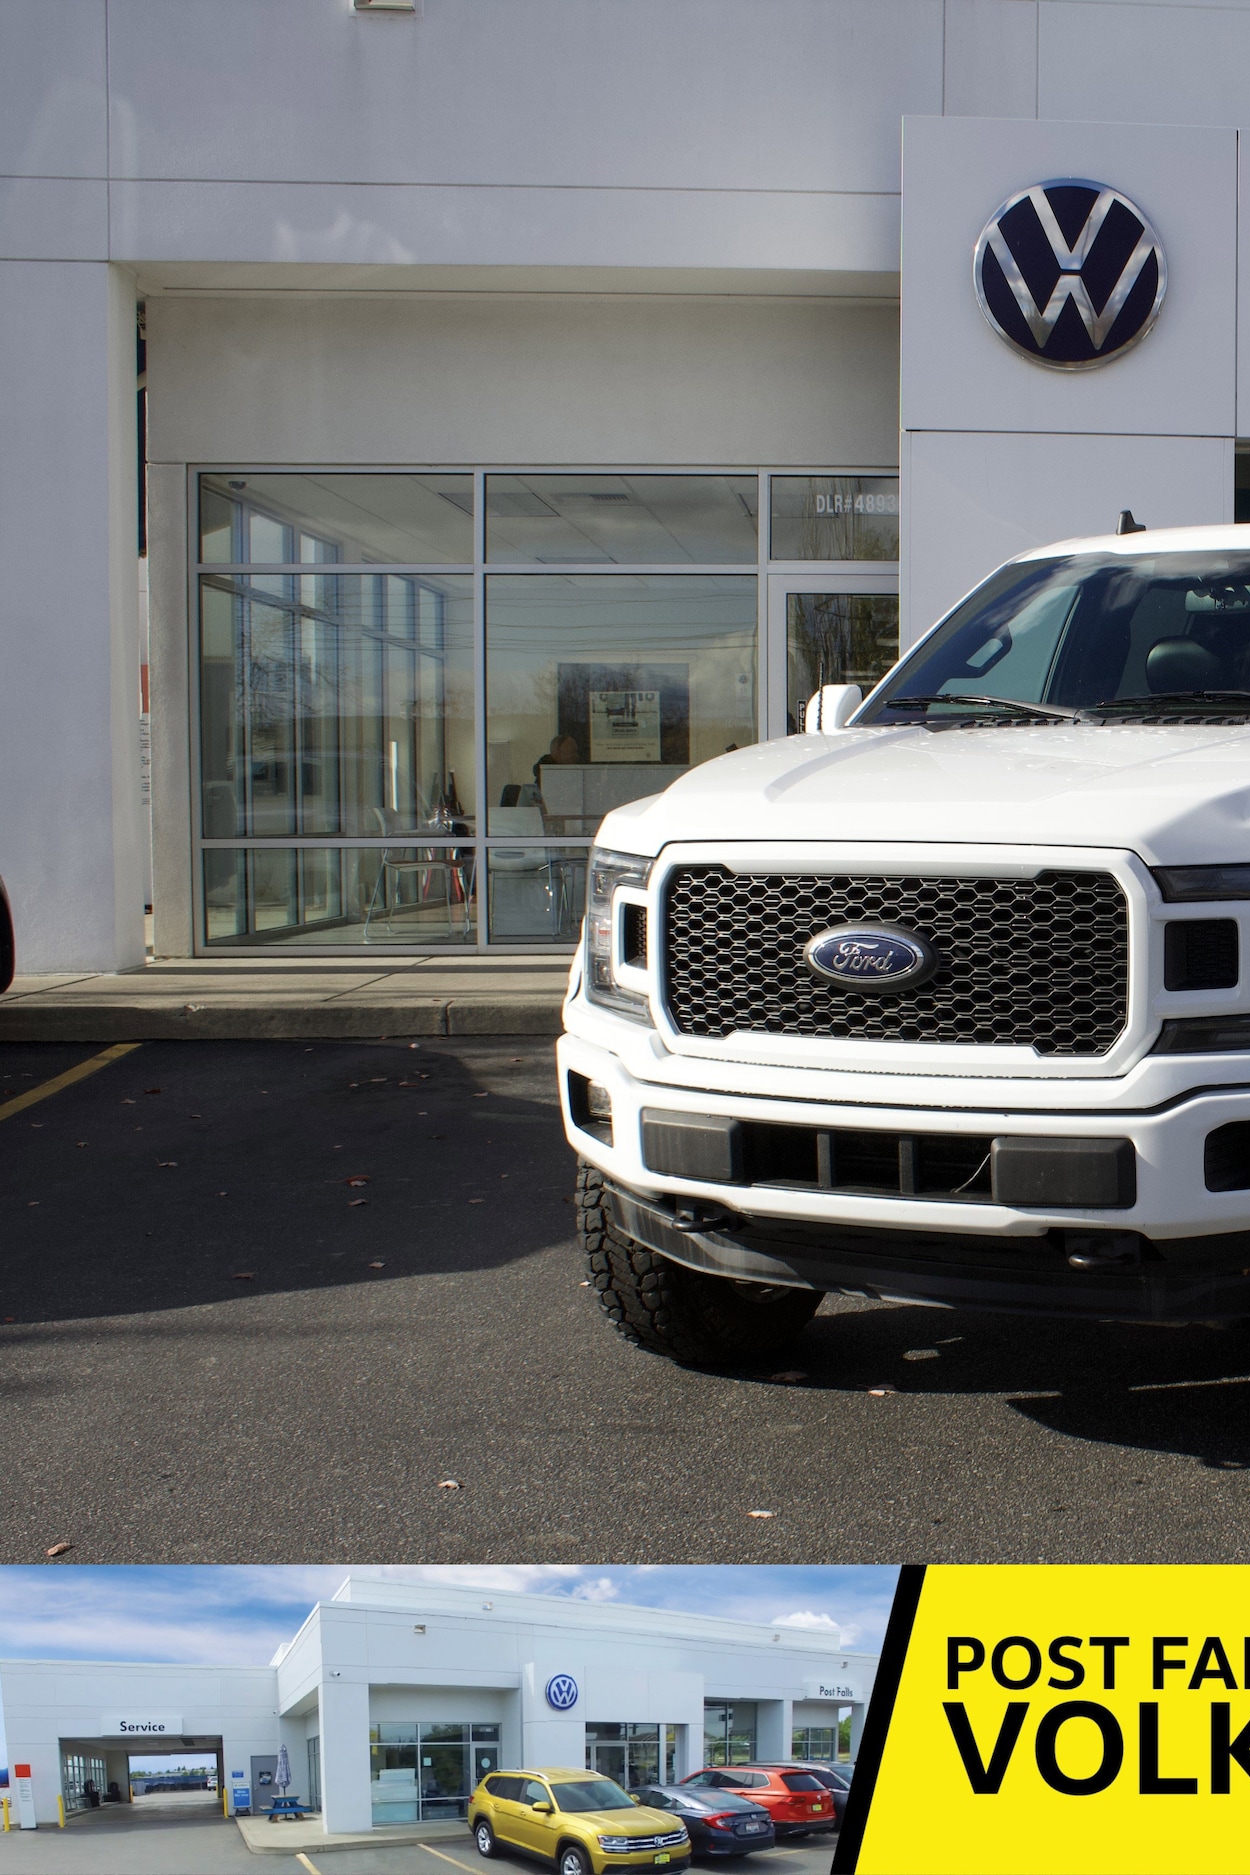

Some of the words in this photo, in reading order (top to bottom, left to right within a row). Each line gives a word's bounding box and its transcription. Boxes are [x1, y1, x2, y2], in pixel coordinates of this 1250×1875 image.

[980, 182, 1161, 358] VW
[816, 494, 896, 513] DLR#4893
[833, 941, 894, 971] Ford
